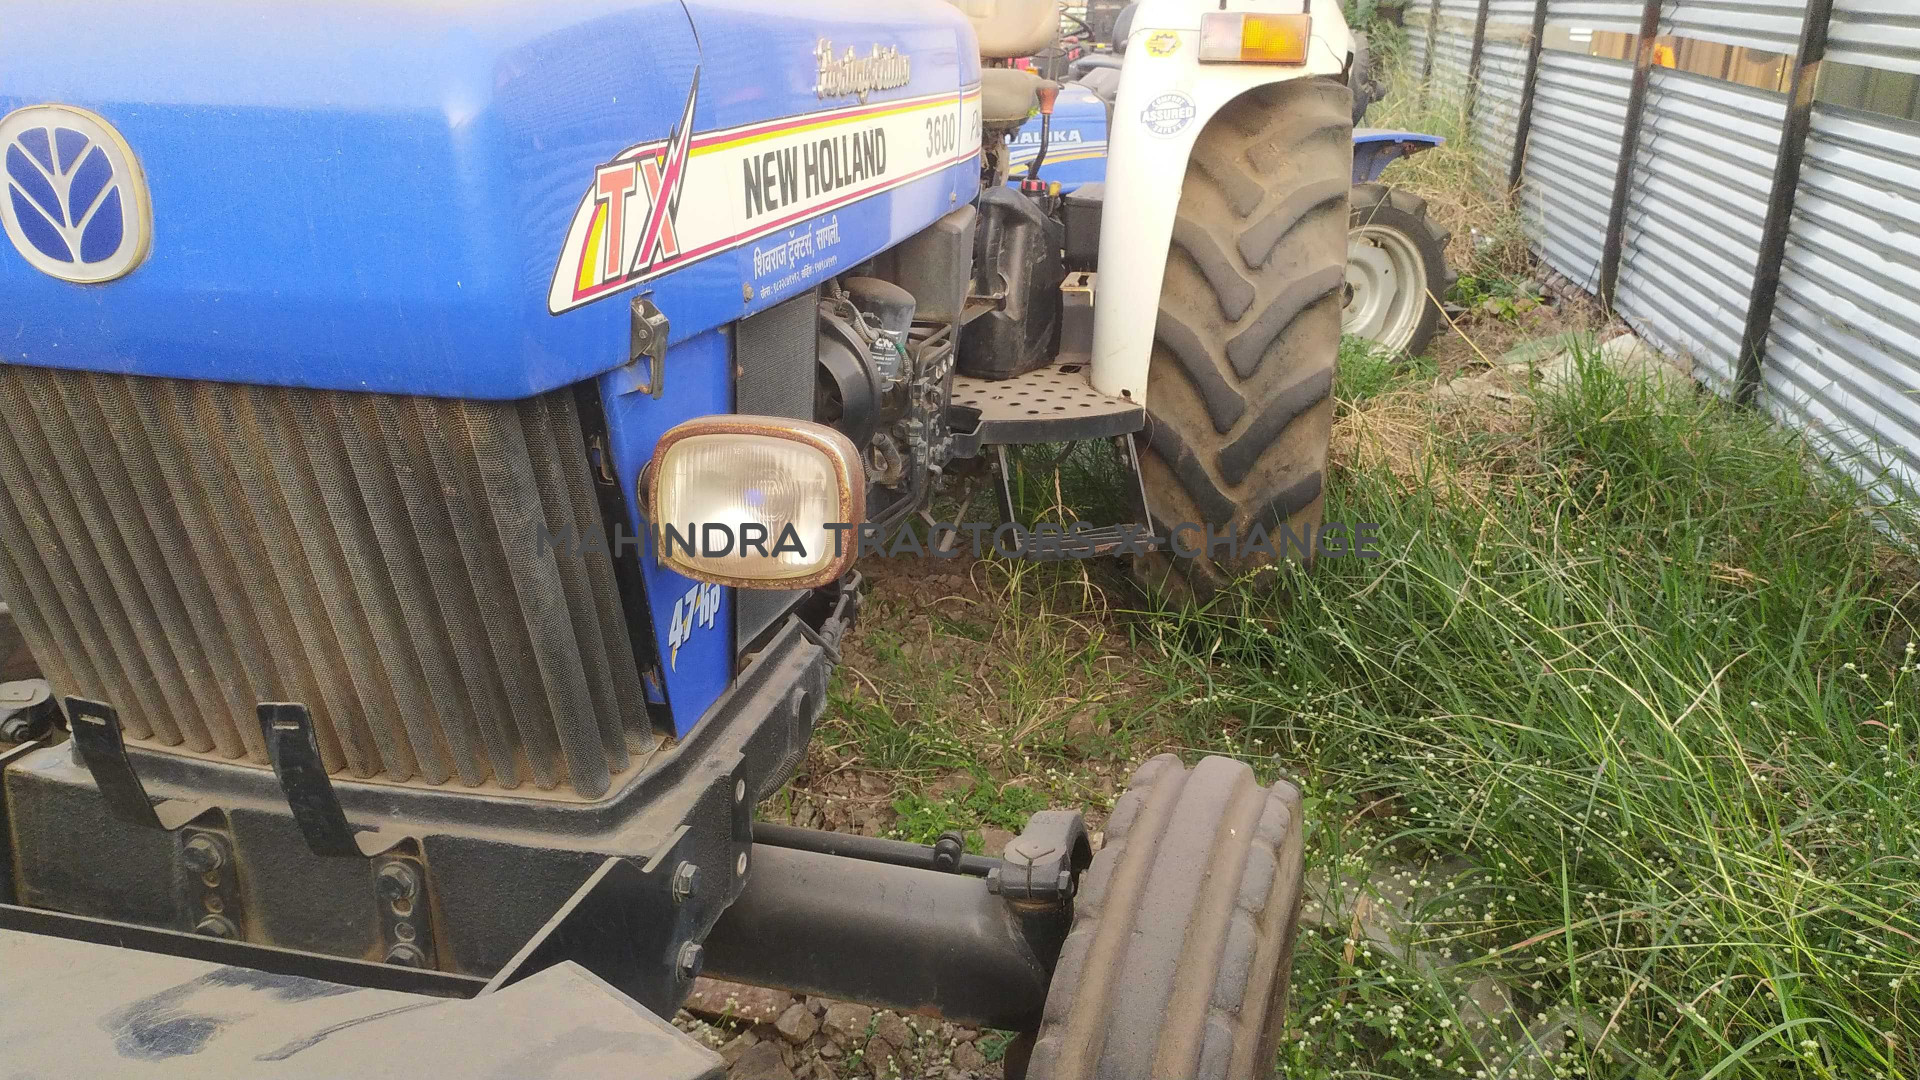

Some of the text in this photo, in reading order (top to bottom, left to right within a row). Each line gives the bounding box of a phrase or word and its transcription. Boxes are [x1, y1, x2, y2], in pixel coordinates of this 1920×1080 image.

[1141, 106, 1196, 122] ASSURED
[743, 144, 799, 219] NEW
[804, 127, 887, 199] HOLLAND
[926, 112, 955, 158] 3600
[594, 138, 690, 284] TX
[753, 246, 787, 280] शिवराज
